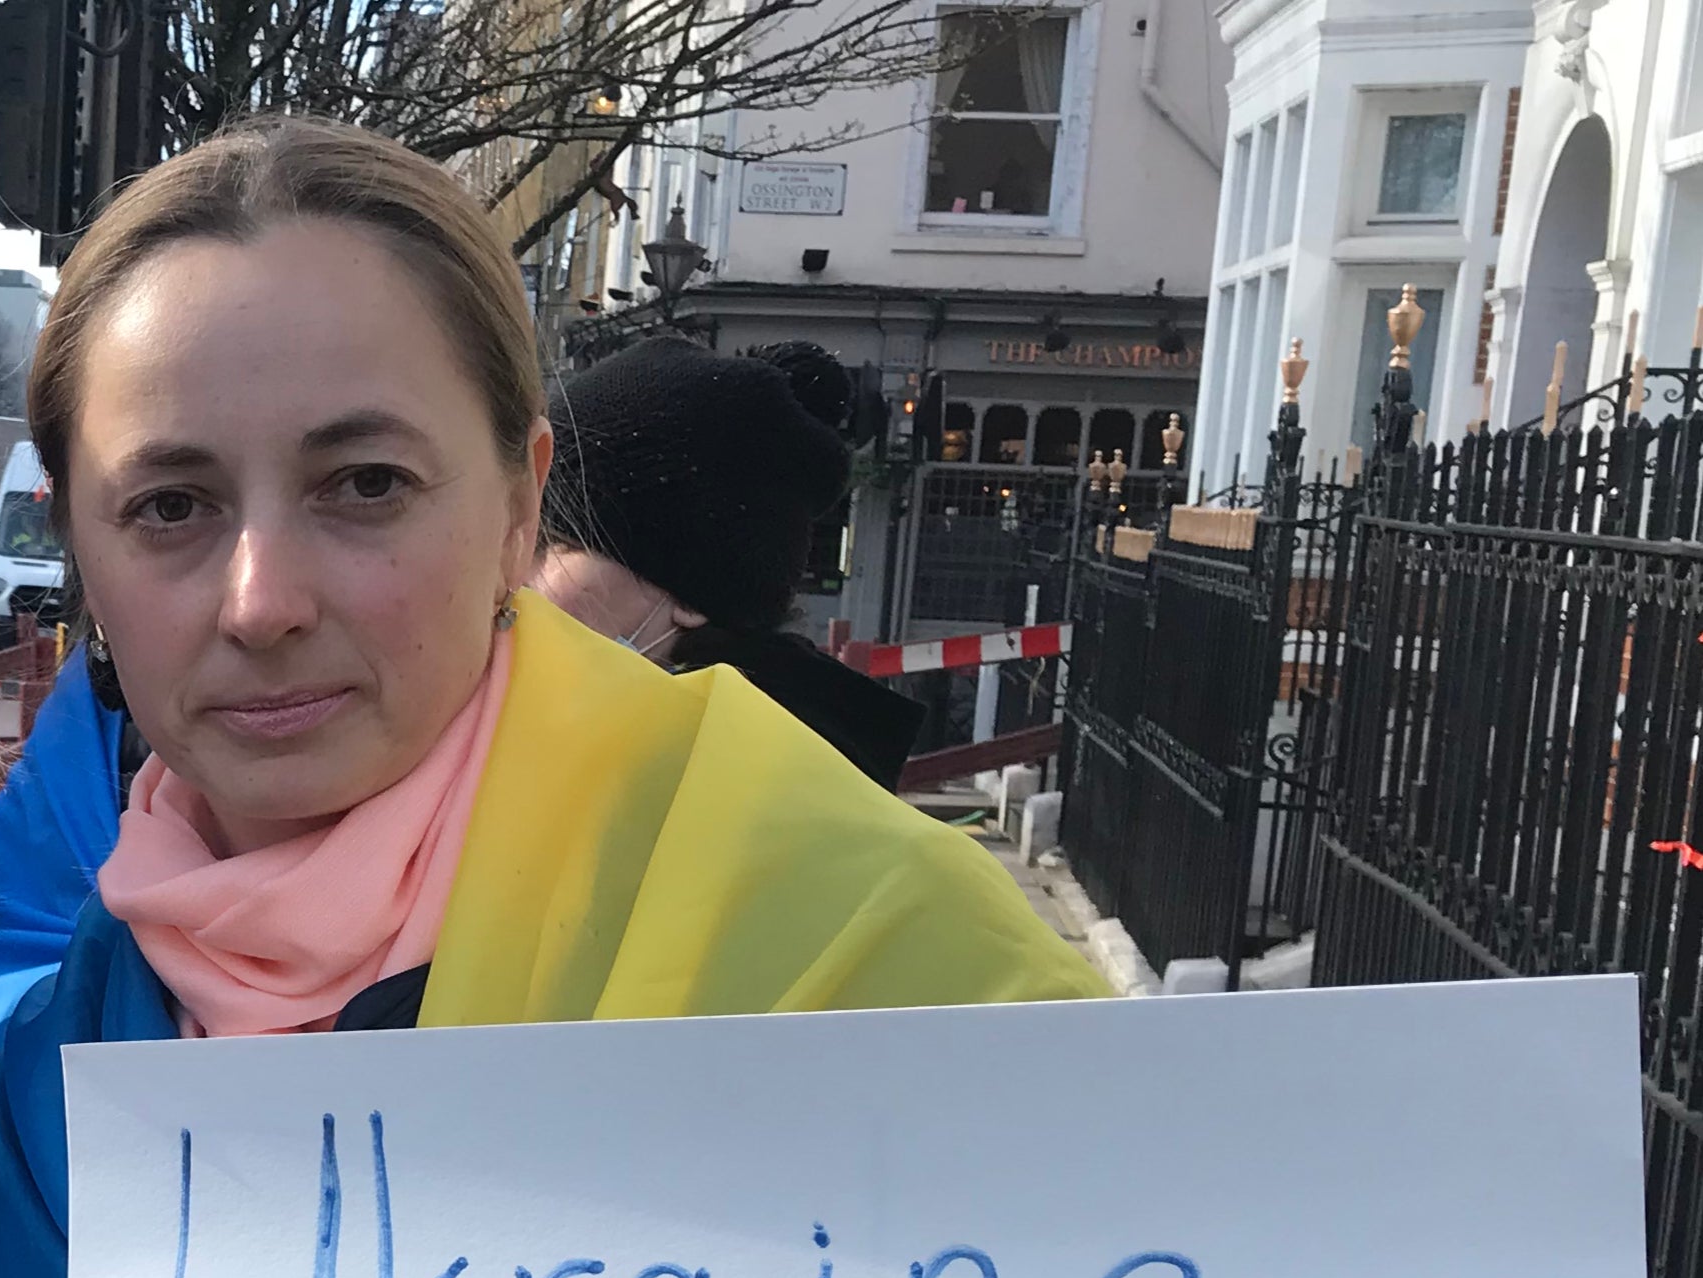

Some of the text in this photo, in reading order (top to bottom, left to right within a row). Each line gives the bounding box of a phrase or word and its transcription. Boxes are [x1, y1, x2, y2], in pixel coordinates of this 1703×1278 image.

[751, 183, 834, 198] OSSINGTON
[746, 197, 797, 210] STREET
[984, 339, 1045, 363] THE
